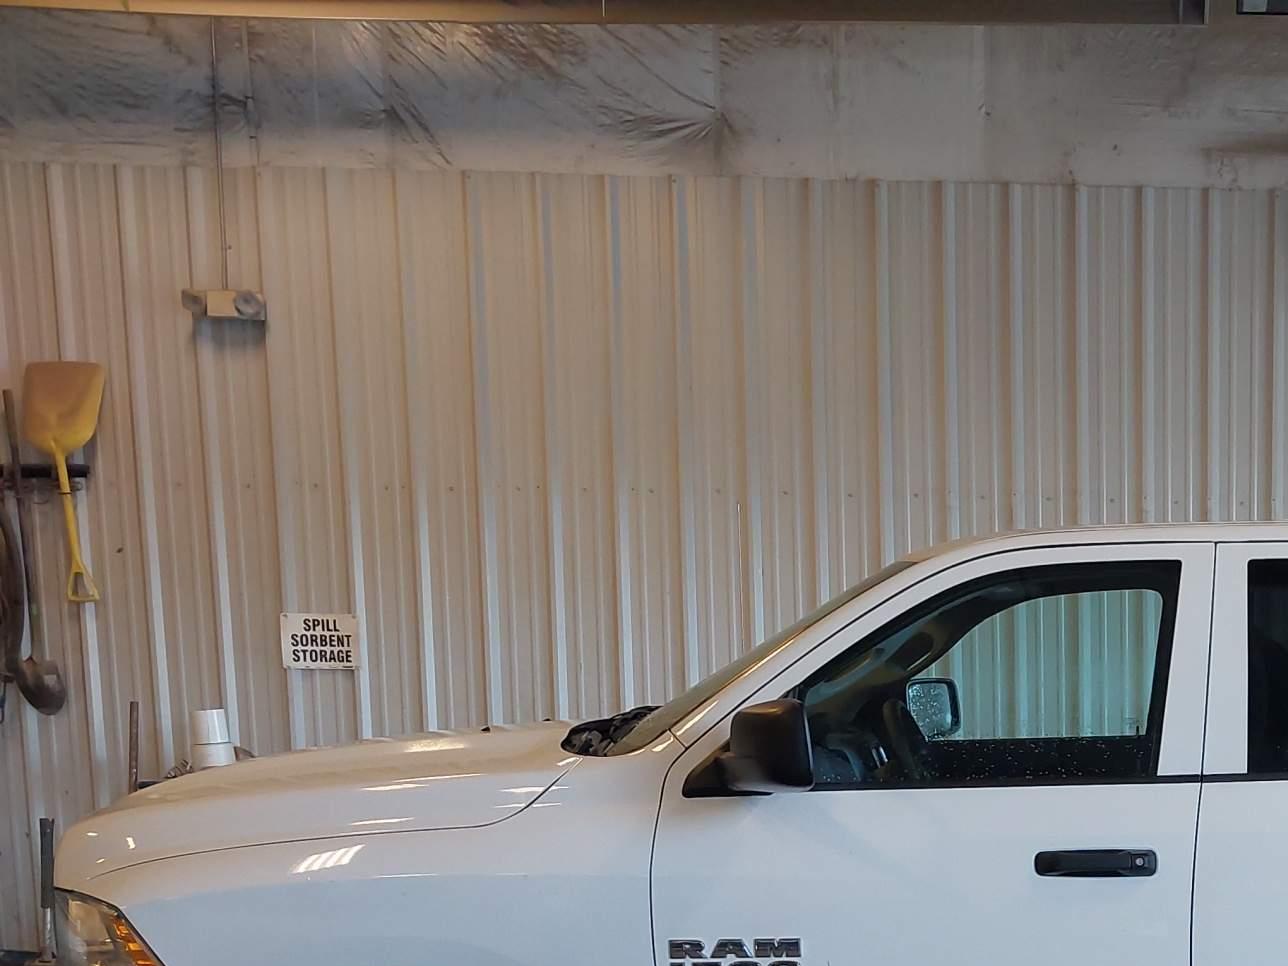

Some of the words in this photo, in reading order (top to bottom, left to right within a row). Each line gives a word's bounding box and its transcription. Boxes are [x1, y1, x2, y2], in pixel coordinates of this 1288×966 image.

[303, 618, 340, 632] SPILL
[291, 633, 352, 647] SORBENT
[292, 649, 352, 663] STORAGE
[668, 938, 802, 959] RAM
